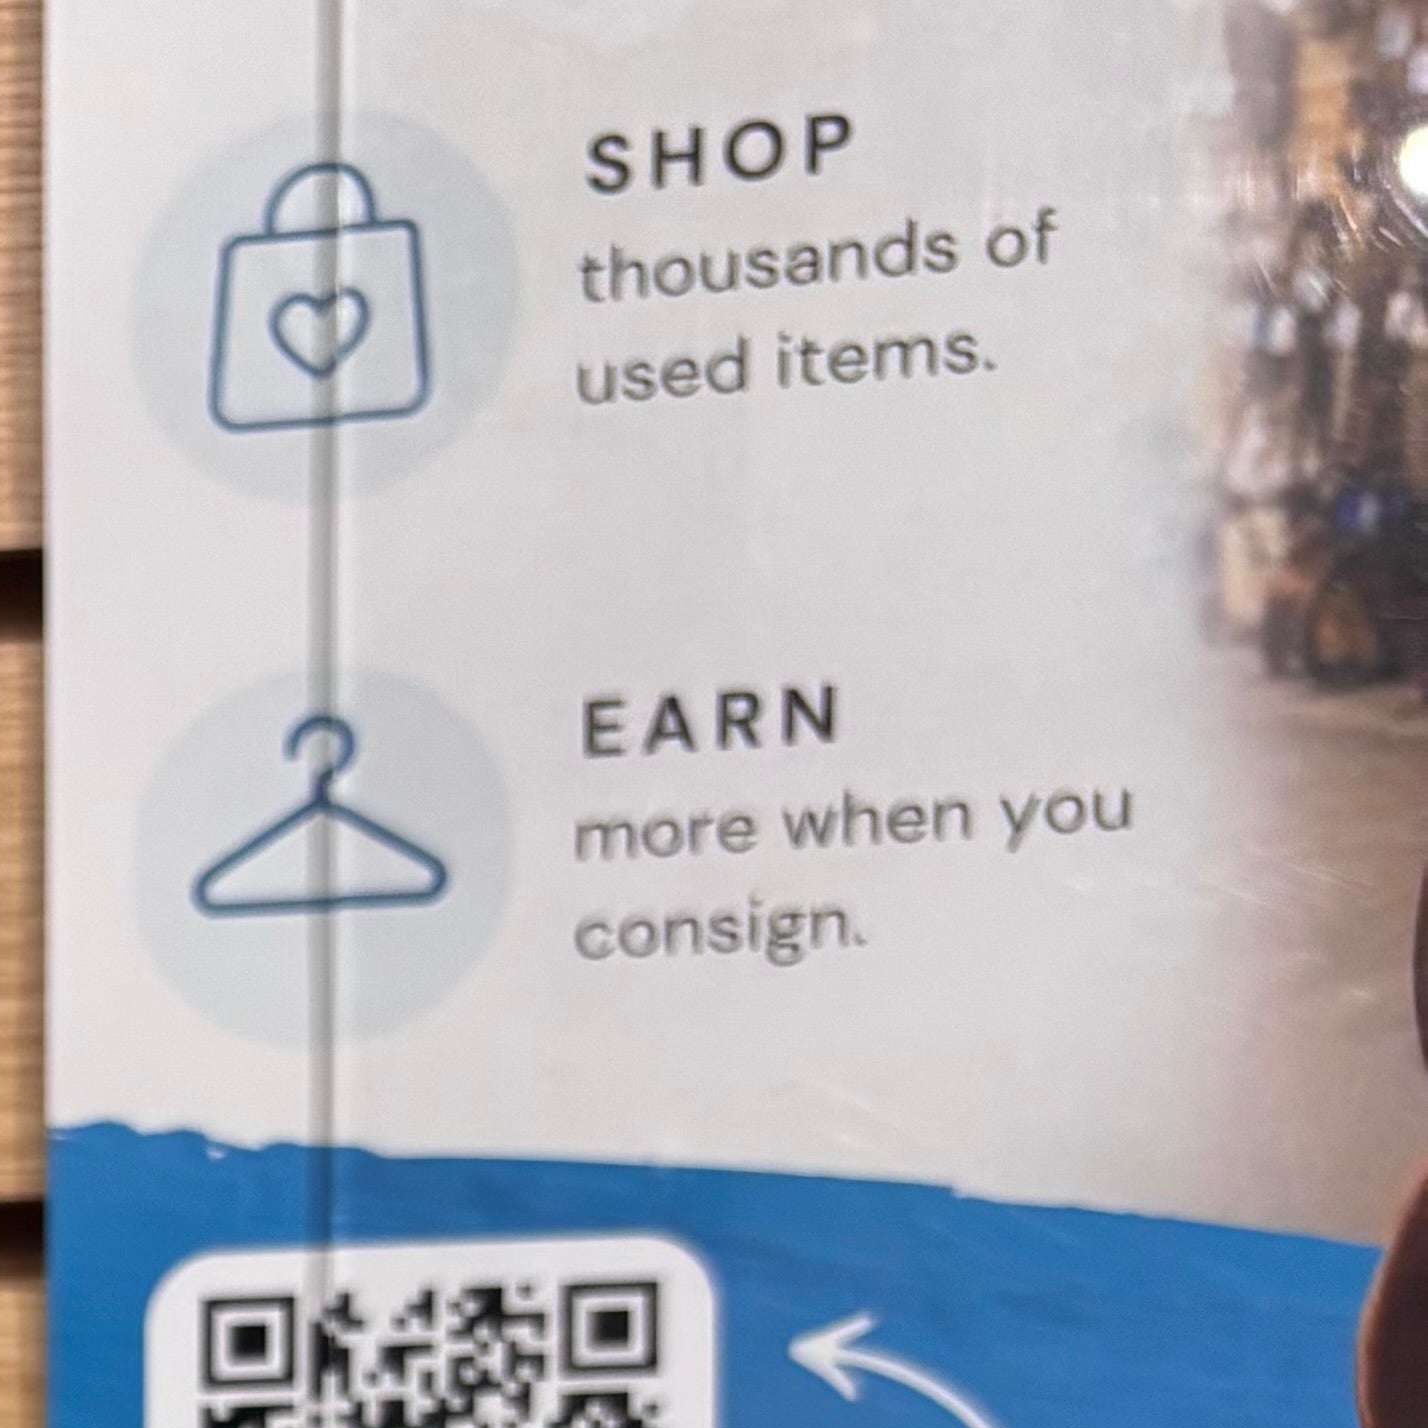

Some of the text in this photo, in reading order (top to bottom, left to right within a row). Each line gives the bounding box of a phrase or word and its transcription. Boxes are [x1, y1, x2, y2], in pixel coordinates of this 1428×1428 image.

[586, 113, 854, 196] SHOP
[578, 204, 1059, 306] thousands of
[575, 327, 998, 407] used items.
[583, 683, 838, 759] EARN
[575, 785, 1134, 862] more when you
[574, 892, 866, 967] consign.
